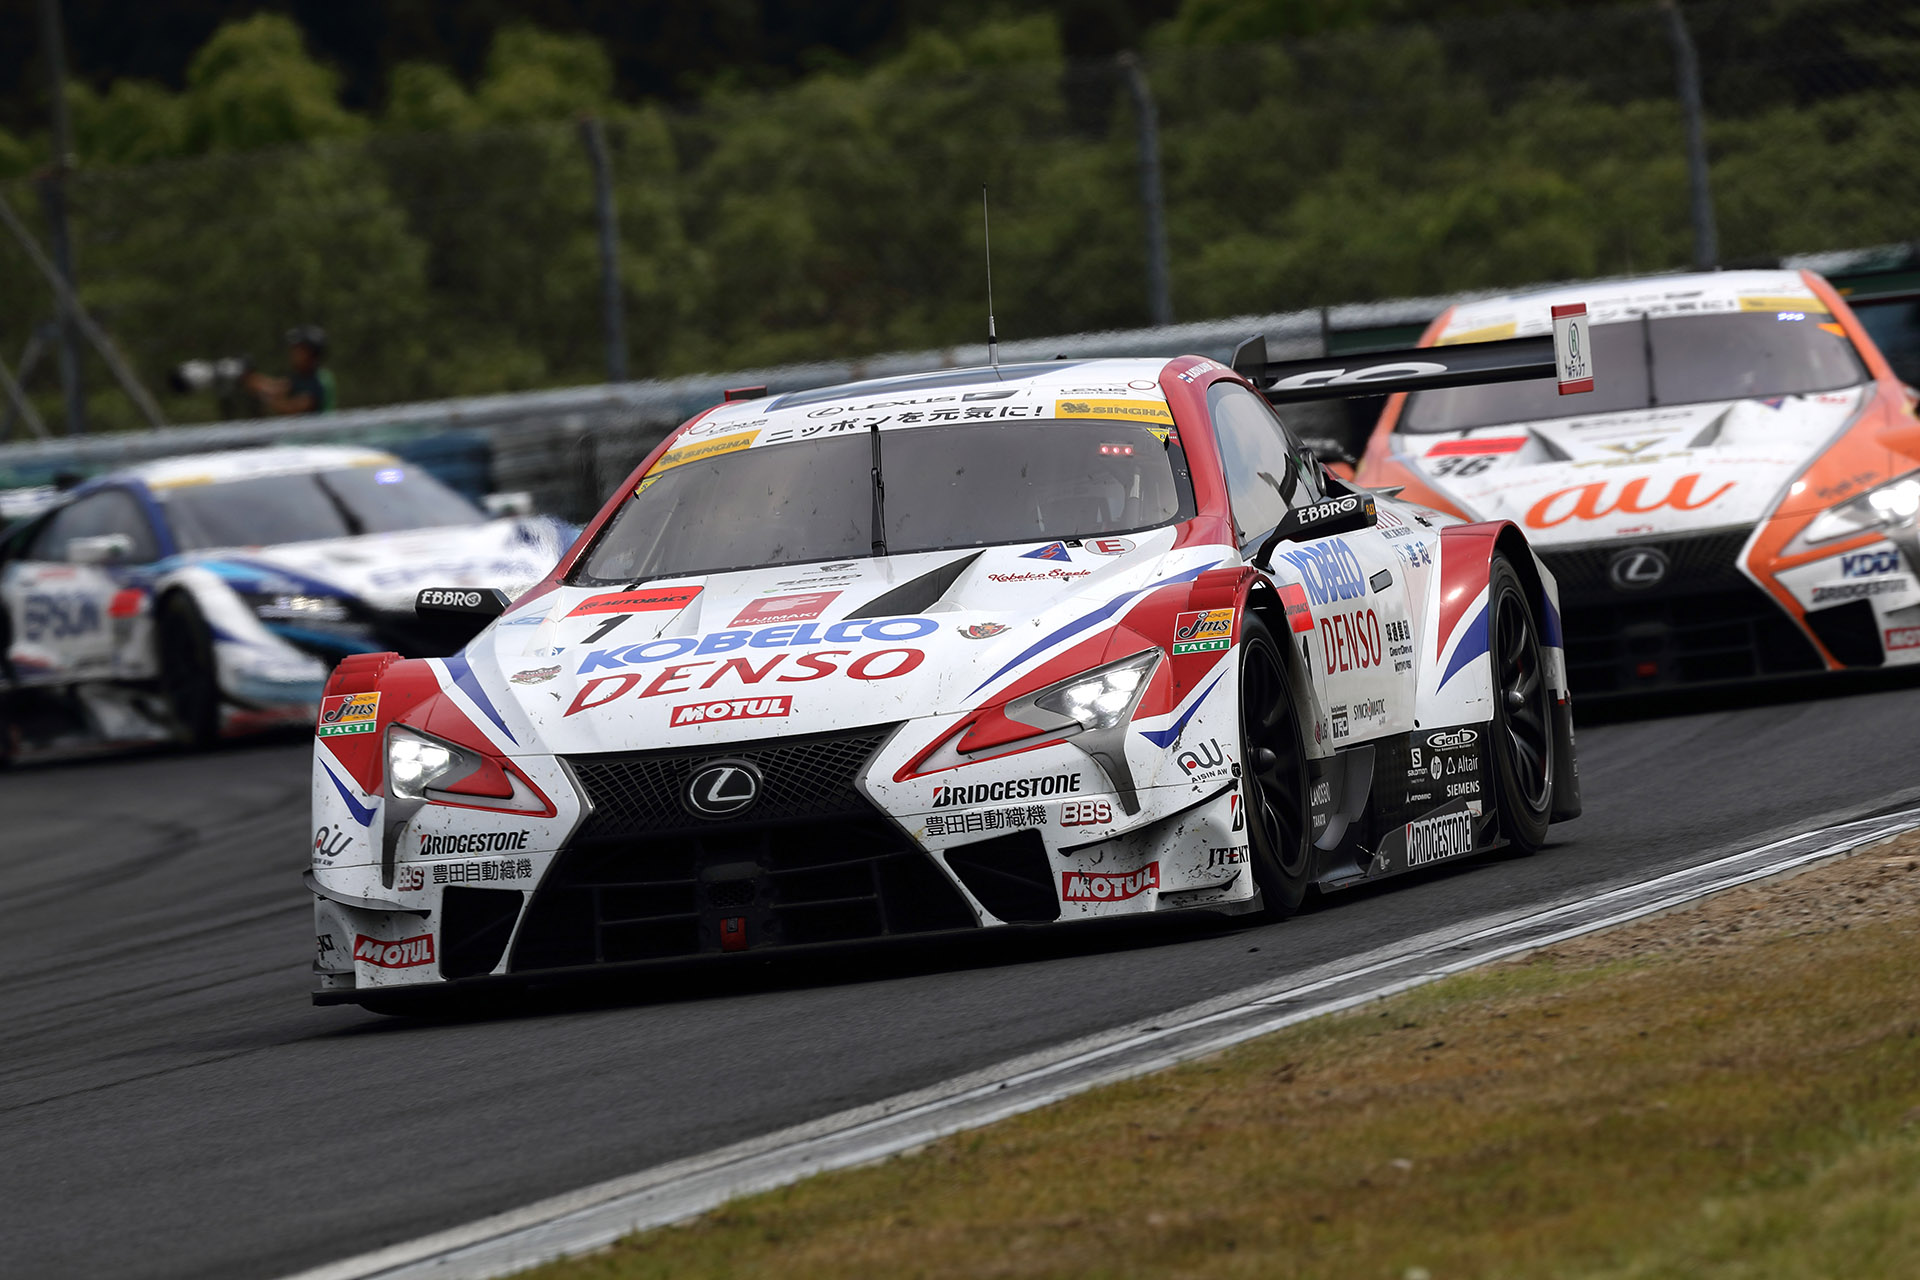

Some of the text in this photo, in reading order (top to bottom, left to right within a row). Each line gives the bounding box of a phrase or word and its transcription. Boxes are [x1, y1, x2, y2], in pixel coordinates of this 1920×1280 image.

[848, 396, 957, 412] LEXUS
[1093, 407, 1170, 418] SINGHA
[1297, 498, 1357, 525] EBBRO
[1524, 473, 1738, 530] au
[988, 571, 1046, 583] Kobelco
[1280, 537, 1366, 607] KOBELCO
[421, 591, 482, 607] EBBRO
[600, 595, 690, 607] AUTOBACS
[580, 614, 633, 644] 1
[733, 612, 818, 625] FUJIMAKI
[576, 617, 940, 675] KOBELCO
[1179, 641, 1224, 652] TACTI
[1320, 608, 1382, 675] DENSO
[563, 648, 925, 717] DENSO
[675, 698, 785, 724] MOTUL
[325, 724, 370, 735] TACTI
[1191, 768, 1228, 784] AISIN AW
[1458, 754, 1478, 773] Altair
[932, 773, 1081, 808] BRIDGESTONE
[1411, 792, 1431, 802] ATOMIC
[1446, 780, 1480, 797] SIEMENS
[925, 805, 1047, 837] 豊田自動織機
[1060, 800, 1113, 827] BBS
[420, 831, 530, 856] BRIDGESTONE
[1408, 813, 1471, 866] BRIDGESTONE
[1207, 845, 1249, 870] JTEKT
[433, 858, 532, 884] 豊田自動織機
[1067, 866, 1156, 898] MOTUL
[356, 938, 432, 965] MOTUL
